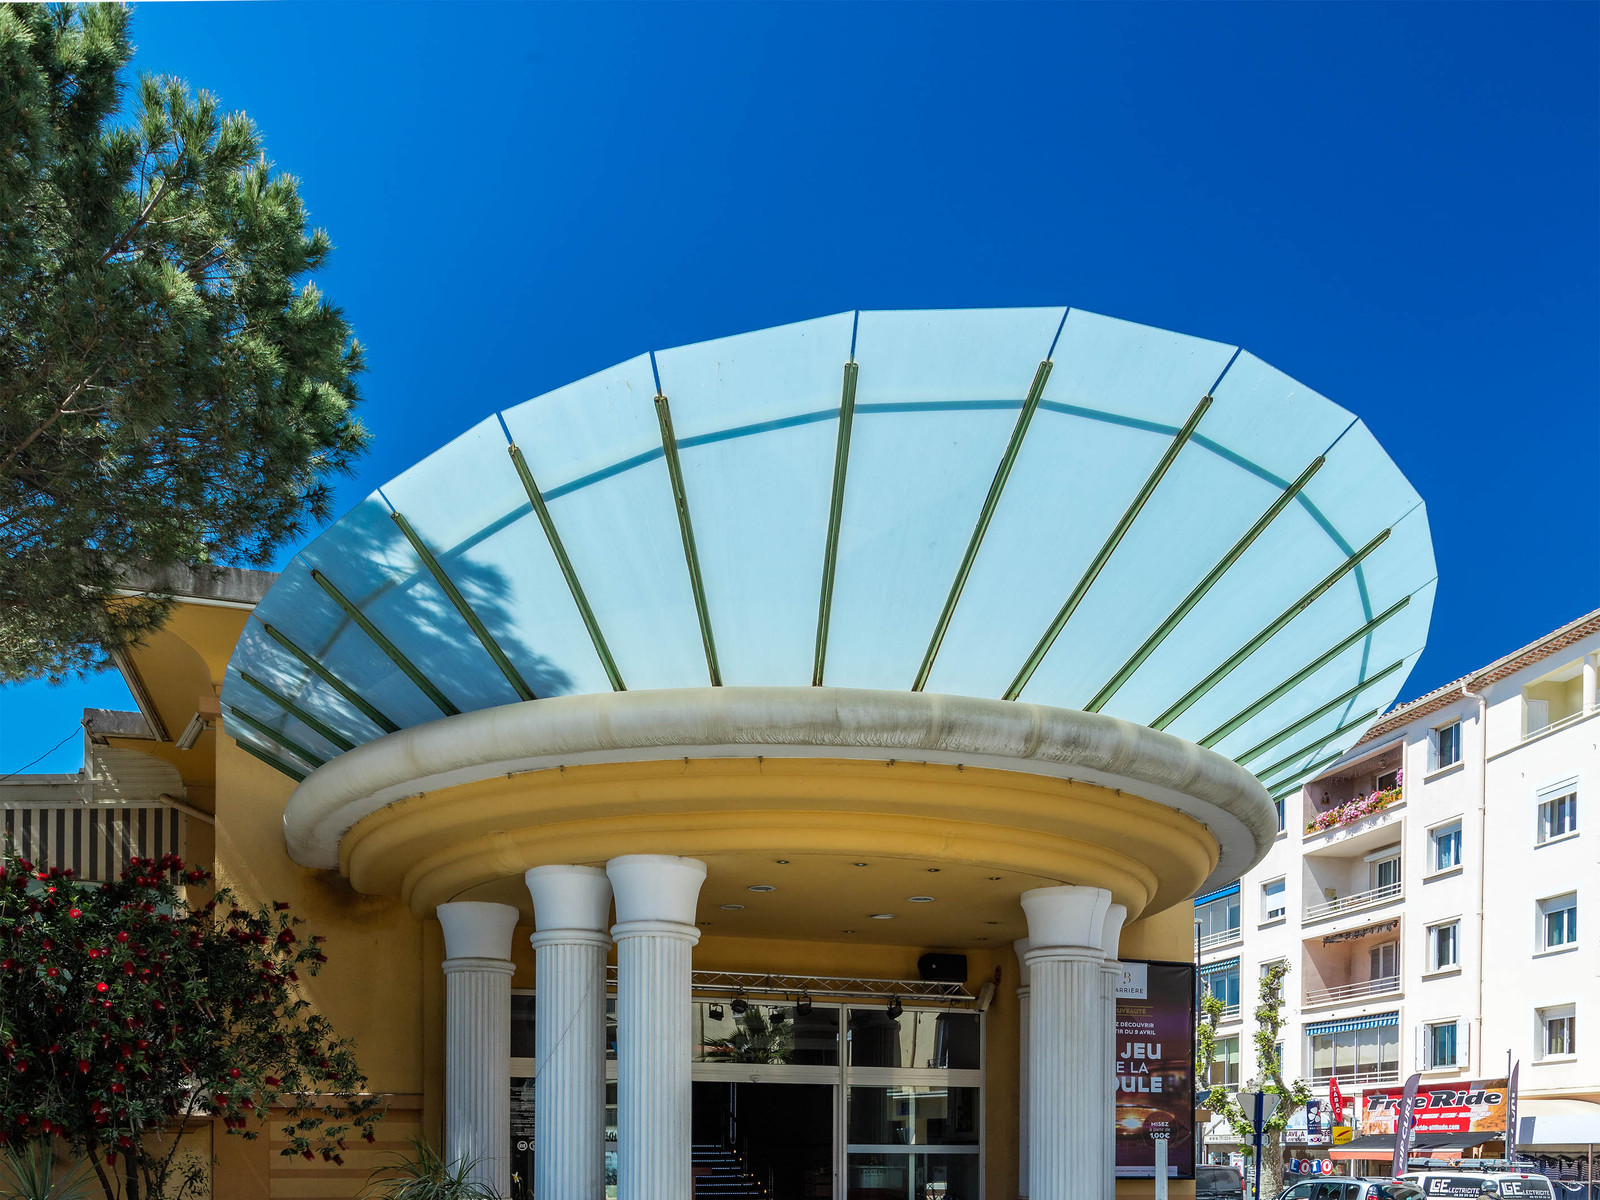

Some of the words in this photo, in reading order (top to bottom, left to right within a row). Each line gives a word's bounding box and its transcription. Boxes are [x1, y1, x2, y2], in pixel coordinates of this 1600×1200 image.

[1120, 1042, 1162, 1060] JEU
[1116, 1061, 1125, 1073] E
[1130, 1061, 1149, 1074] LA
[1332, 1086, 1341, 1114] TABAC
[1428, 1089, 1503, 1109] Ride
[1401, 1096, 1413, 1140] CURL
[1290, 1158, 1333, 1175] LOTO
